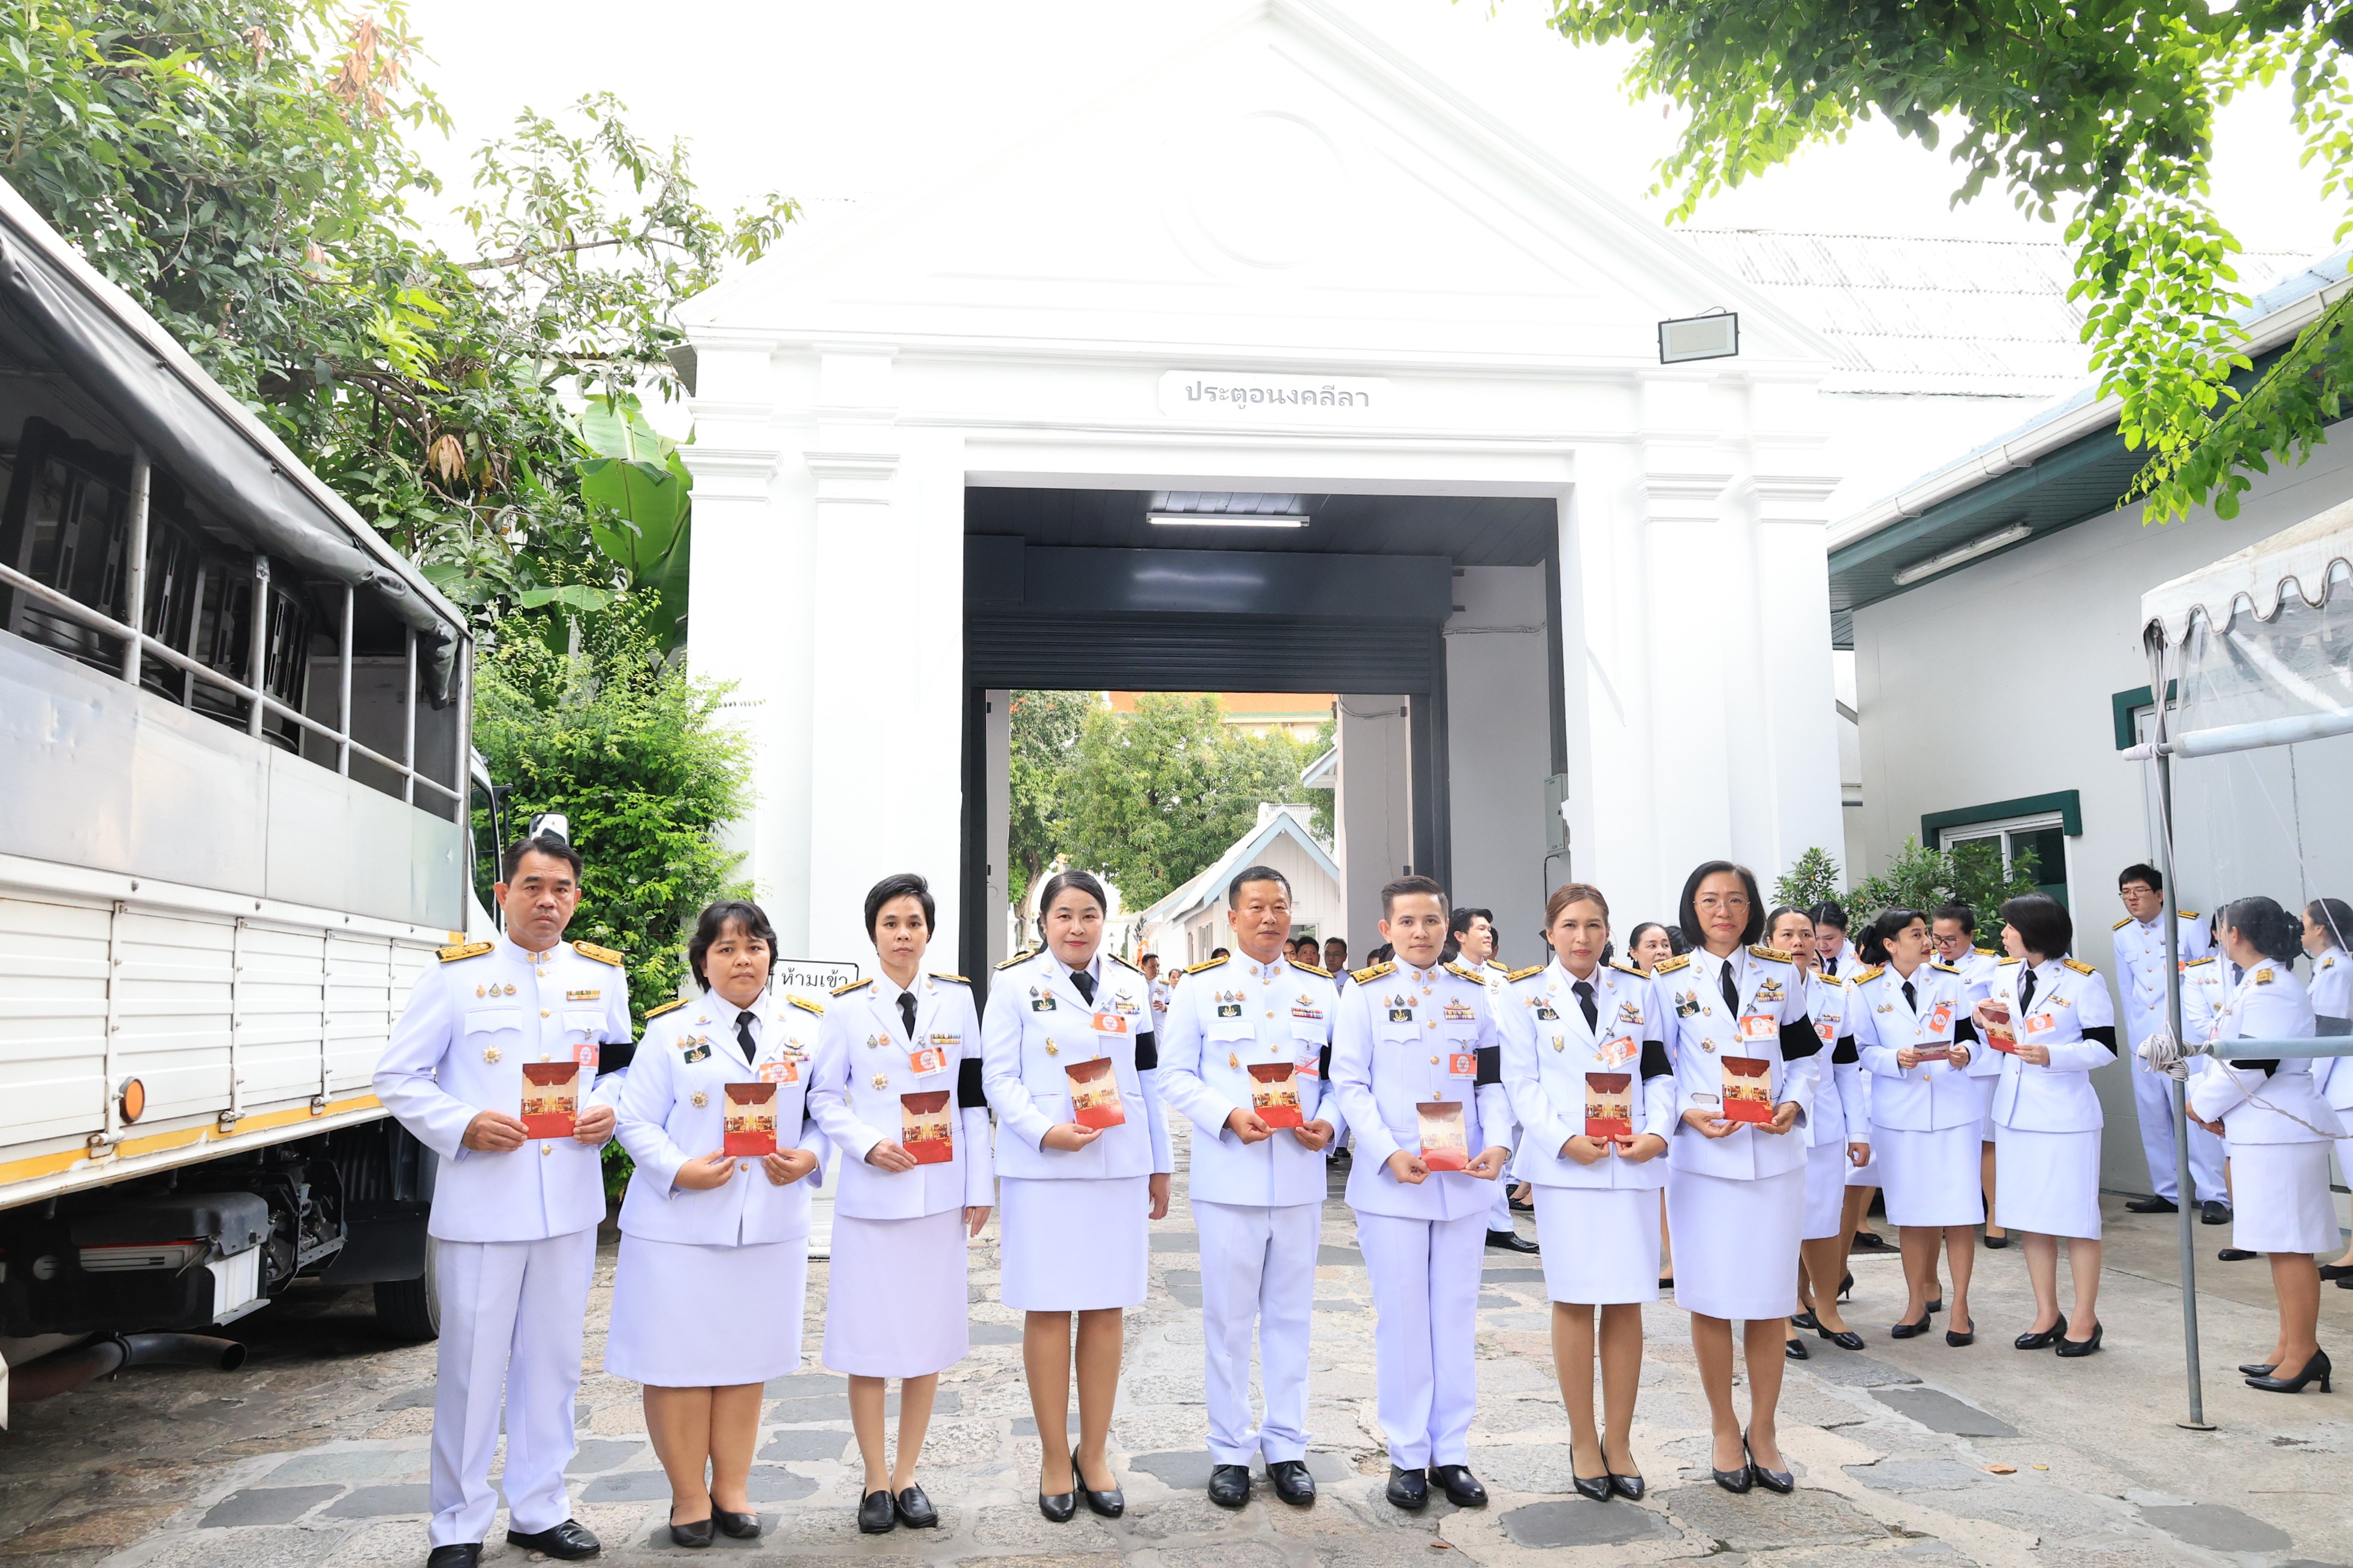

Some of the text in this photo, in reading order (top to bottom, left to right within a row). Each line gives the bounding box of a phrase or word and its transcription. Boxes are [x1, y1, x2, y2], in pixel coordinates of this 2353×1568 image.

[1185, 381, 1369, 410] ประตูอนงคลีลา
[781, 967, 848, 988] ห้ามเข้า
